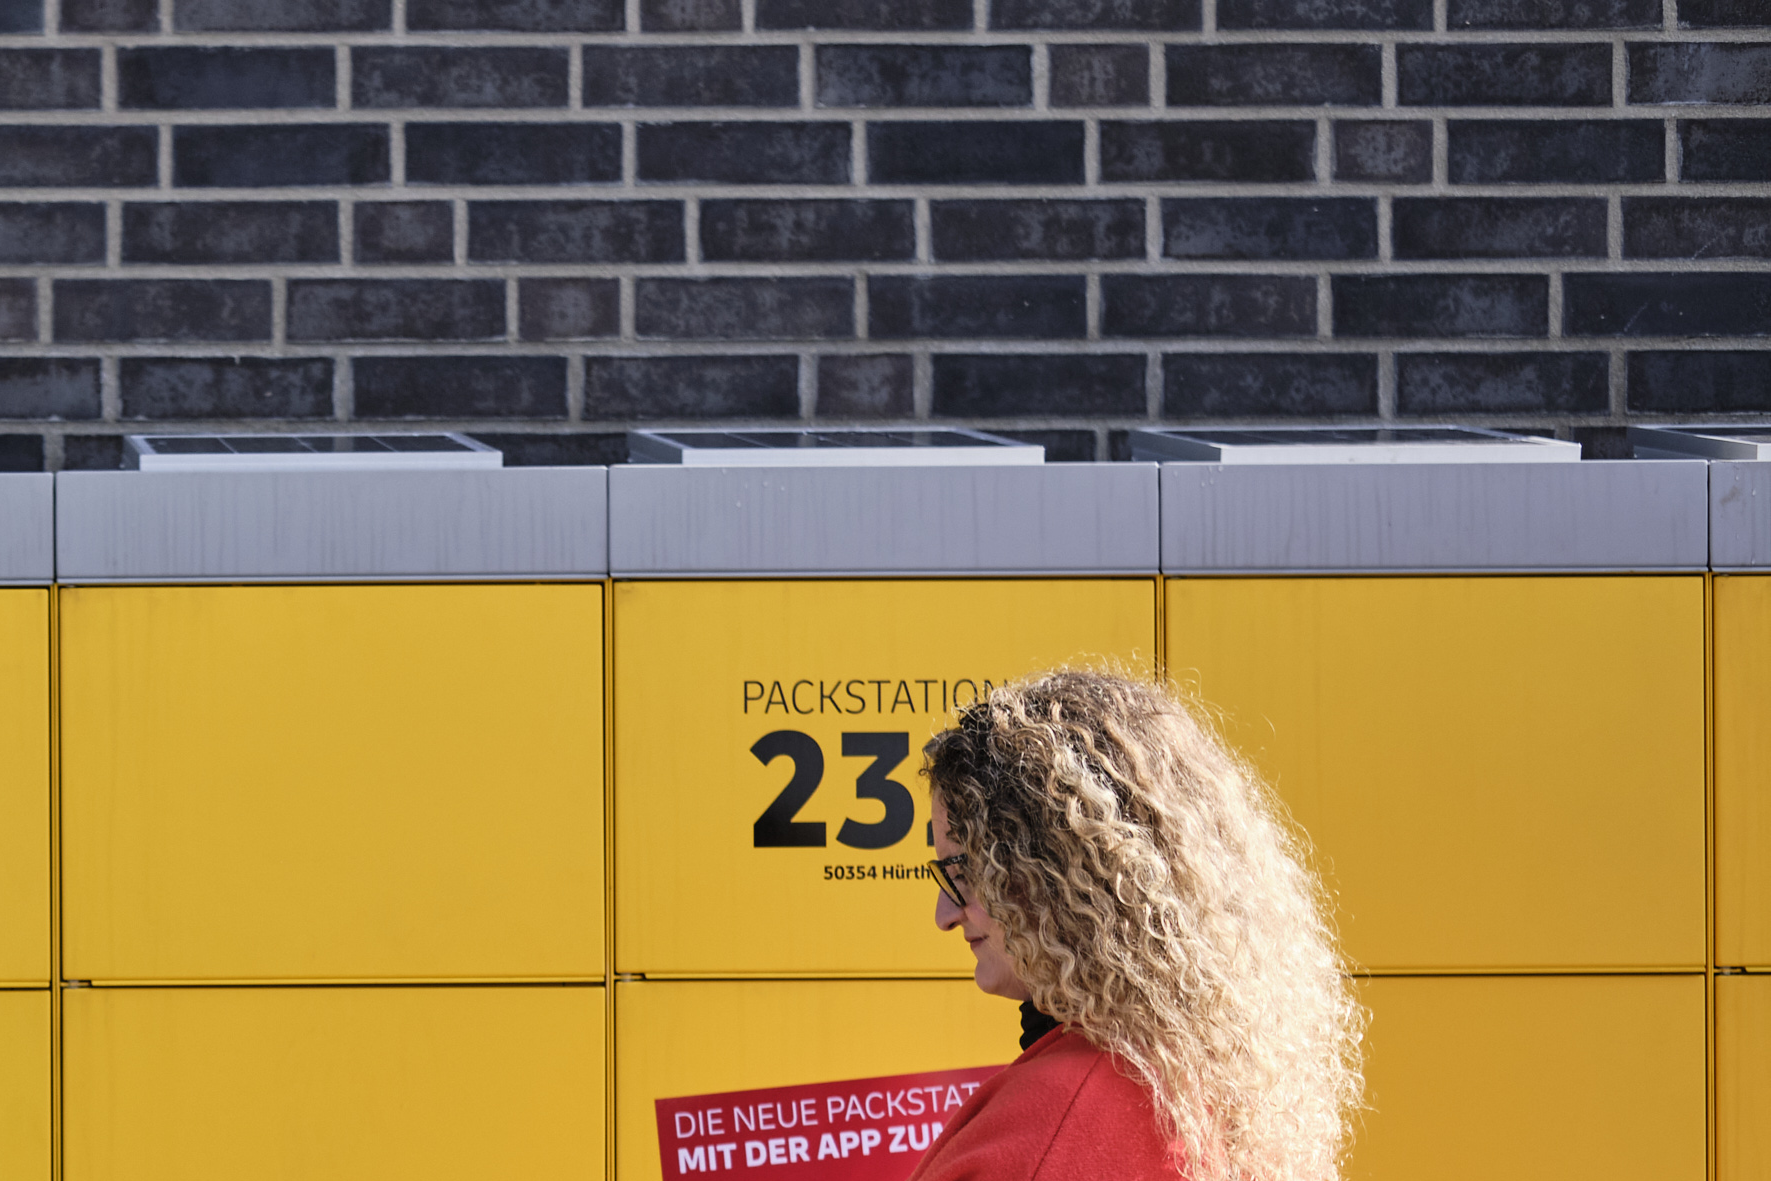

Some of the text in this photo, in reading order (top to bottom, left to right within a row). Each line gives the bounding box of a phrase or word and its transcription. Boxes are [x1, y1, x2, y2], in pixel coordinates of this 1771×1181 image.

[750, 729, 938, 850] 23
[823, 865, 878, 880] 50354
[674, 1108, 725, 1139] DIE
[733, 1098, 818, 1132] NEUE
[678, 1143, 737, 1174] MIT
[745, 1135, 810, 1167] DER
[817, 1129, 881, 1160] APP
